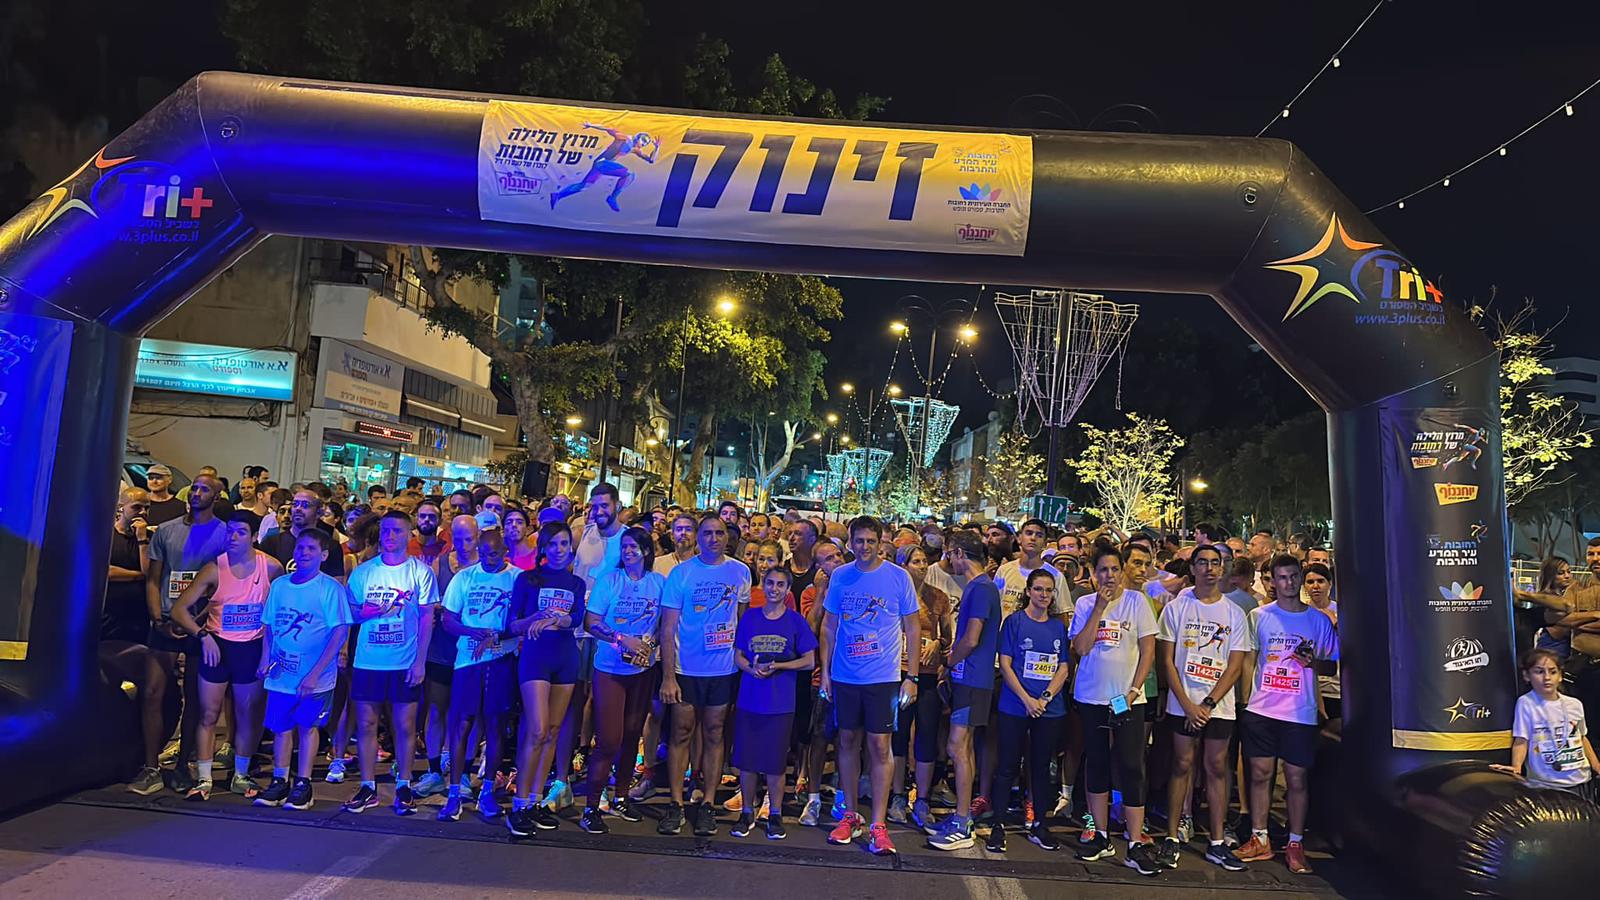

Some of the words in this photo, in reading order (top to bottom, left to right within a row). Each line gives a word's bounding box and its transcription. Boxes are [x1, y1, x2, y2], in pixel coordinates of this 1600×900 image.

[507, 127, 558, 145] הלילה
[560, 132, 599, 149] מרוץ
[495, 143, 553, 163] רחובות
[557, 148, 583, 166] של
[954, 157, 980, 166] המדע
[984, 159, 997, 167] עיר
[959, 164, 997, 174] והתרבות
[655, 127, 939, 228] זינוק
[1376, 259, 1444, 304] Tri+
[1354, 312, 1446, 325] www.3plus.co.il
[1416, 431, 1444, 442] הלילה
[1444, 431, 1465, 442] מרוץ
[1411, 441, 1442, 452] רחובות
[1444, 441, 1458, 450] של
[1428, 549, 1459, 558] המדע
[1461, 549, 1477, 557] עיר
[1436, 557, 1478, 566] והתרבות
[1034, 663, 1051, 673] 2401
[1273, 677, 1292, 687] 1425
